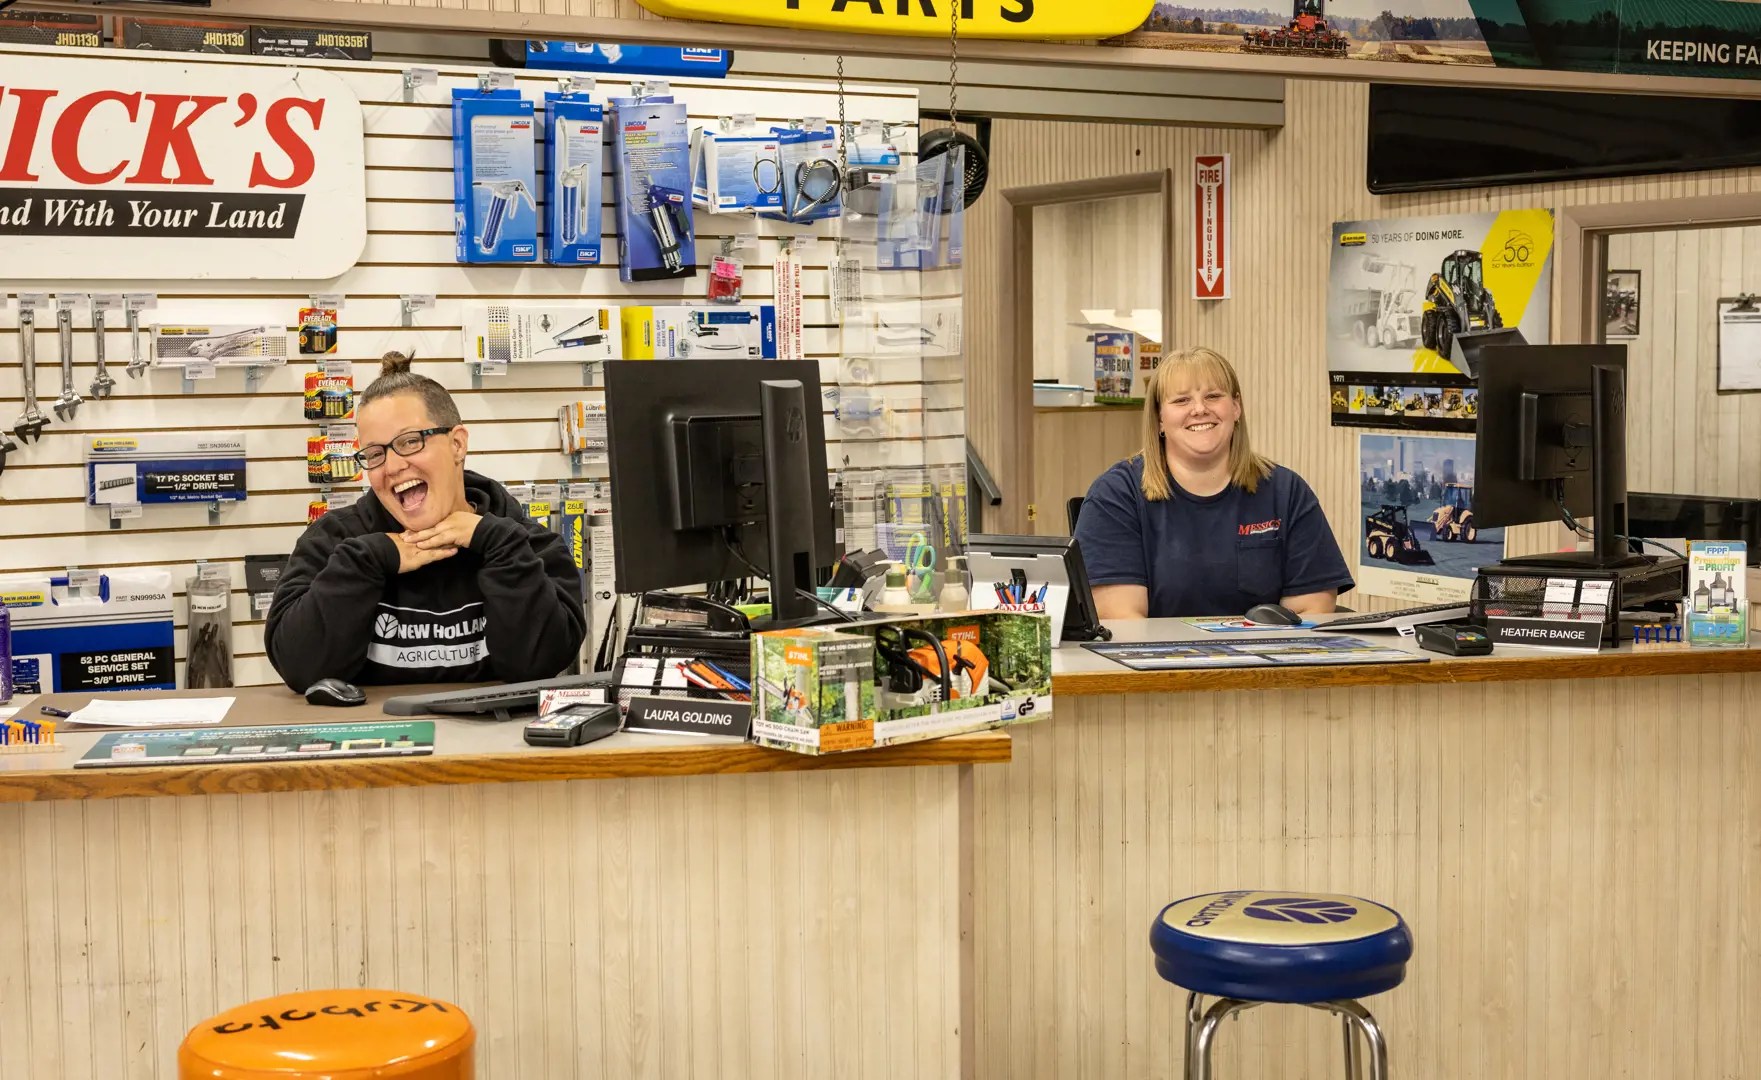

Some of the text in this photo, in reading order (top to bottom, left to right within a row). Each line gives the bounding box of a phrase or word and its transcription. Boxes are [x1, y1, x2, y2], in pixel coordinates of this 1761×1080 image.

[55, 33, 99, 48] JHD1130
[203, 32, 245, 47] JHD1130
[315, 34, 369, 48] JHD1635BT
[1647, 39, 1761, 65] KEEPING FA
[0, 85, 326, 189] ICK'S
[1199, 169, 1220, 183] FIRE
[43, 199, 115, 227] With
[128, 199, 198, 228] Your
[205, 202, 285, 229] Land
[1371, 229, 1465, 244] 50 YEARS OF DOING MORE.
[1104, 358, 1116, 372] BIG
[1116, 358, 1131, 372] BOX
[318, 379, 348, 387] EVEREADY
[1333, 375, 1345, 383] 1971
[182, 474, 217, 482] SOCKET
[192, 482, 218, 490] DRIVE
[1705, 564, 1736, 572] PROFIT
[130, 594, 166, 602] SN99953A
[397, 616, 487, 639] NEW HOLLAN
[1500, 627, 1586, 640] HEATHER BANGE
[951, 631, 977, 640] STIHL
[80, 652, 156, 665] 52 PC GENERAL
[396, 644, 481, 662] AGRICULTURE
[788, 651, 809, 660] STIHL
[87, 662, 150, 674] SERVICE SET
[93, 674, 145, 685] 3/8" DRIVE
[643, 708, 732, 726] LAURA GOLDING
[836, 722, 867, 732] WARNING
[213, 999, 448, 1035] Kubota
